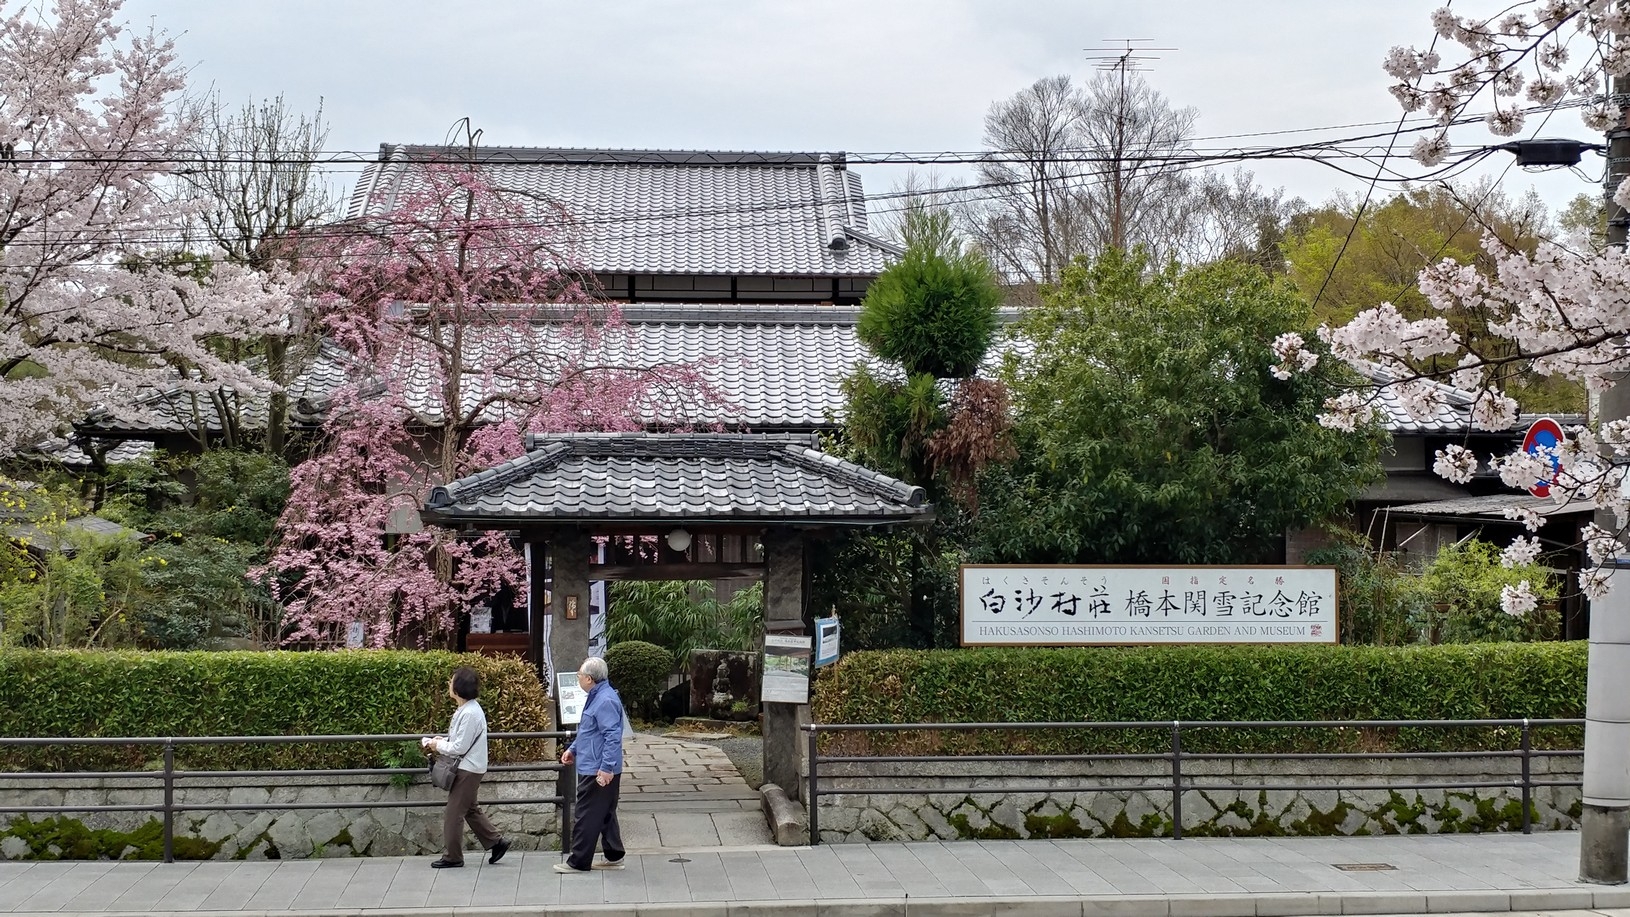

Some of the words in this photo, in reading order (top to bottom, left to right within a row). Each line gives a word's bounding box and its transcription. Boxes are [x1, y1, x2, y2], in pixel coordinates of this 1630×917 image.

[982, 575, 1108, 586] はくさそんそう
[1125, 588, 1323, 618] 橋本関雪記念館
[979, 626, 1059, 636] HAKUSASONSO
[1062, 626, 1127, 636] HASHIMOTO
[1130, 626, 1184, 636] KANSETSU
[1187, 626, 1231, 636] GARDEN
[1233, 626, 1257, 636] AND
[1260, 626, 1306, 636] MUSEUM
